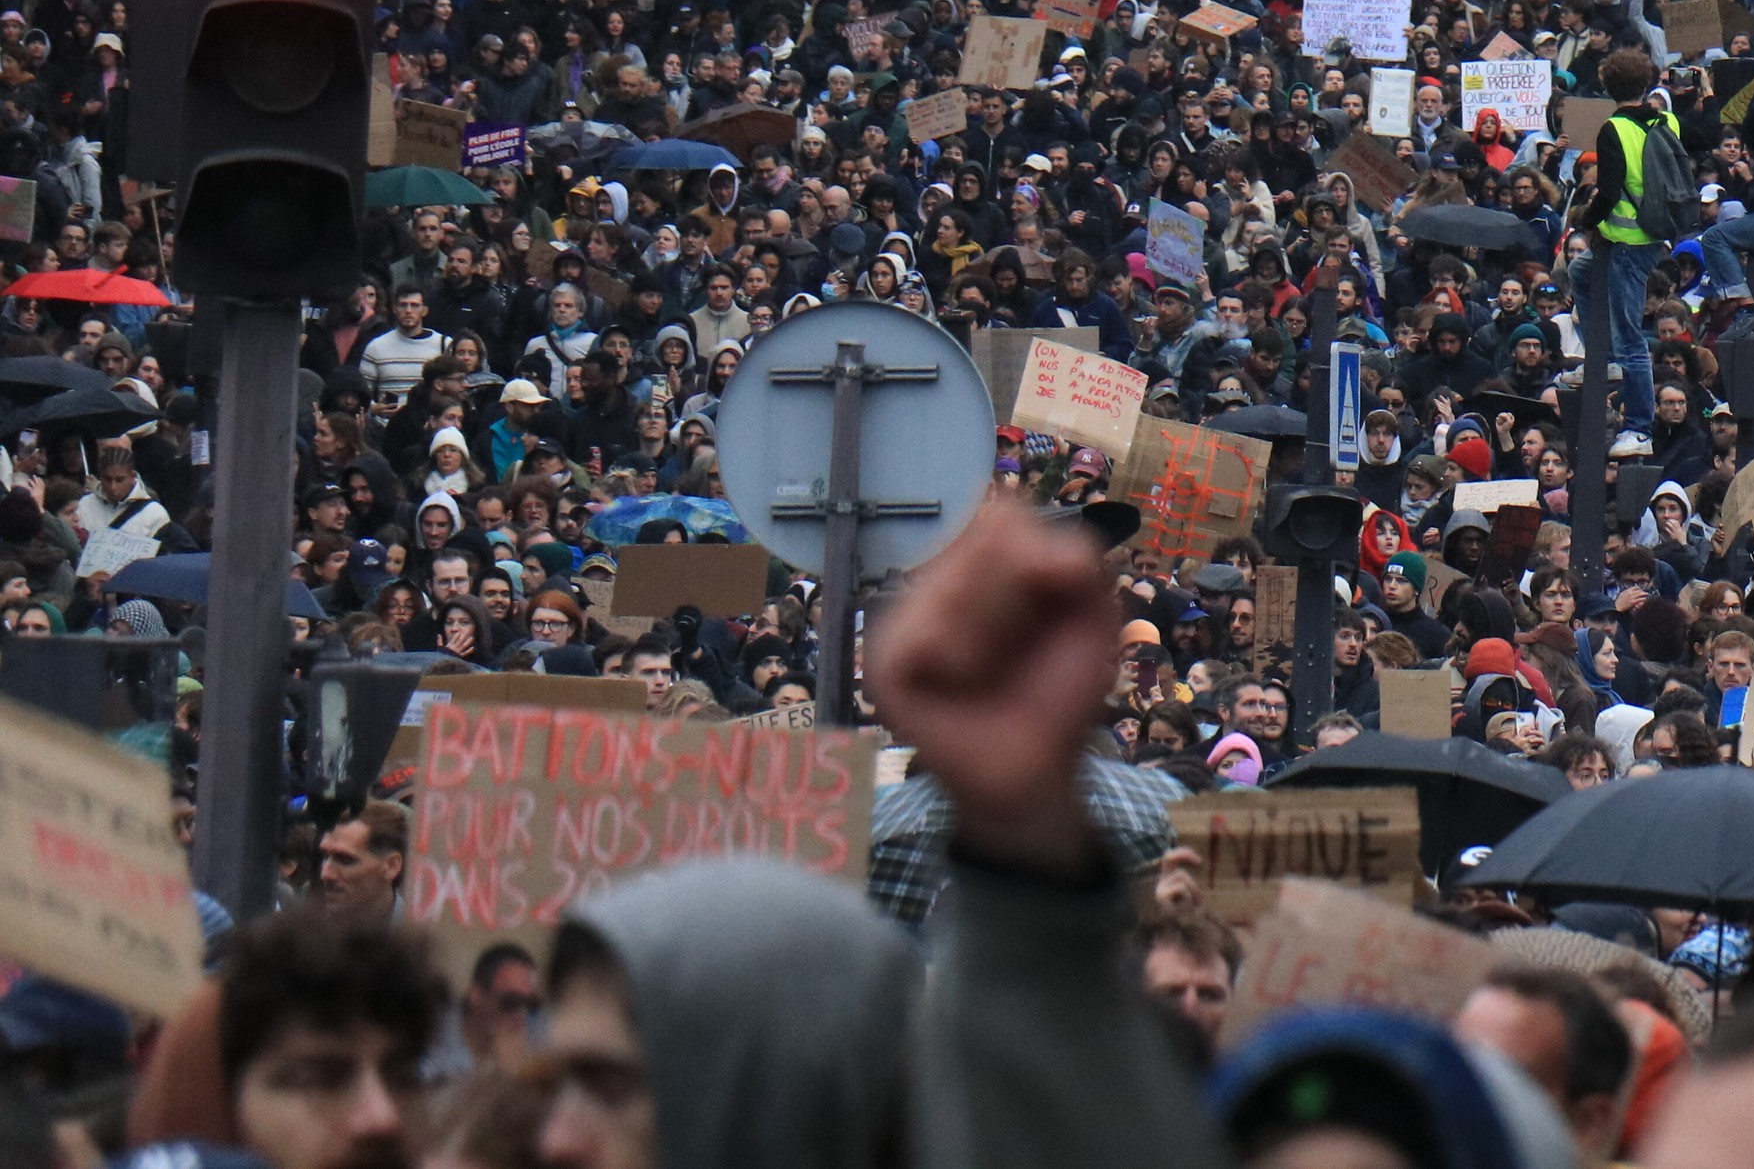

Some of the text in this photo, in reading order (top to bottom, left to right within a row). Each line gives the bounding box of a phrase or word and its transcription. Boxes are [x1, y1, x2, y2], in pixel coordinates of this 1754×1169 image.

[1465, 62, 1536, 77] MA QUESTION
[1039, 360, 1060, 371] NOS
[1075, 355, 1086, 365] A
[1036, 385, 1056, 399] DE
[1038, 374, 1122, 405] ON A PEUR
[415, 788, 536, 860] POUR
[552, 793, 652, 868] NOS
[407, 857, 529, 931] DANS
